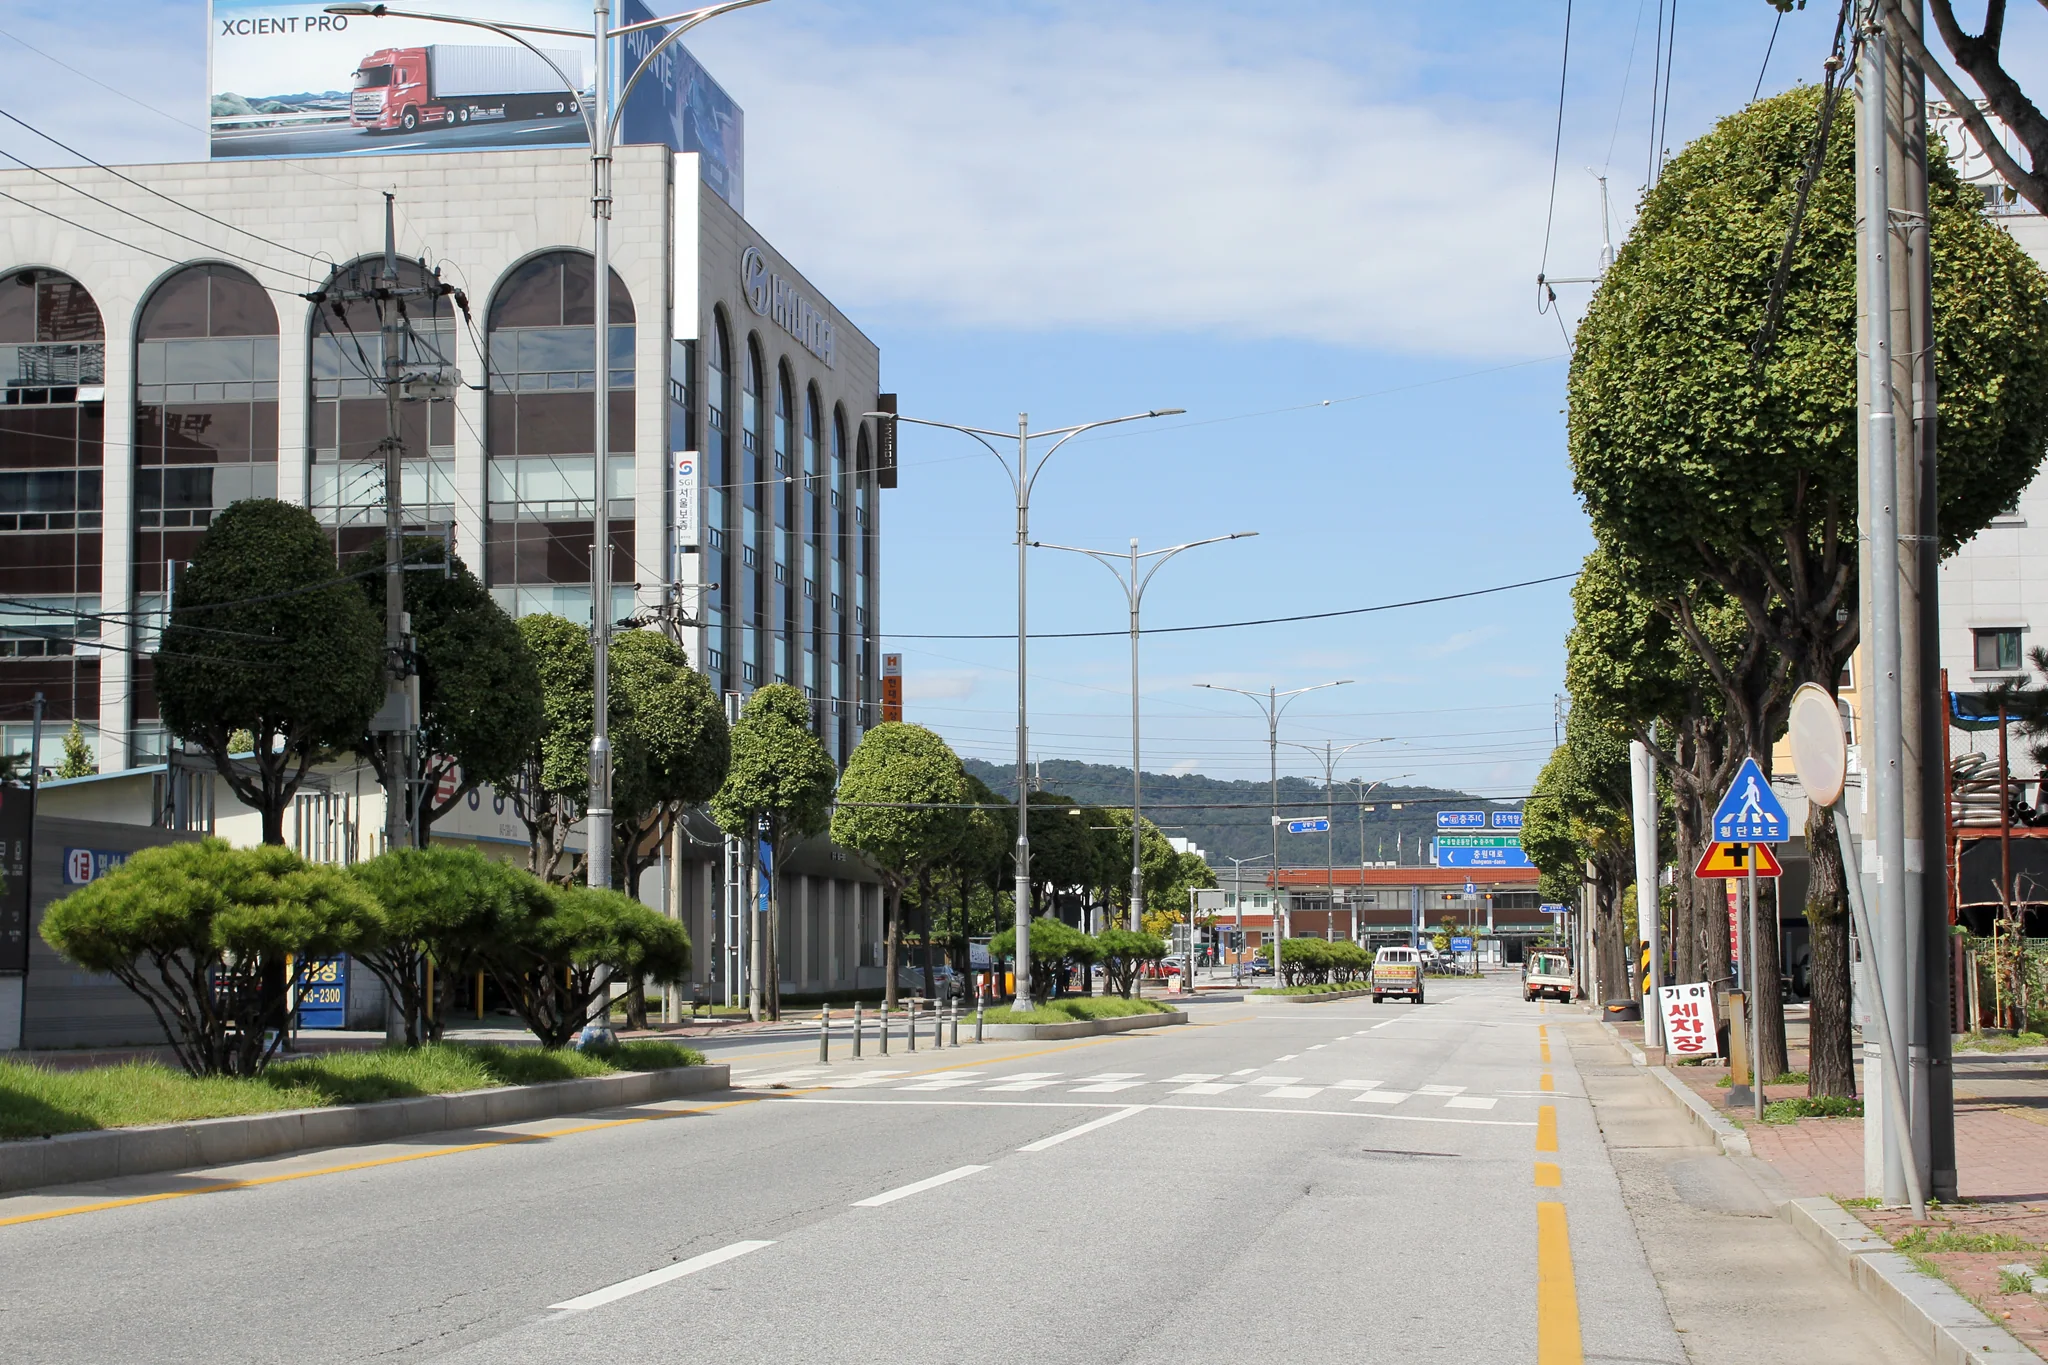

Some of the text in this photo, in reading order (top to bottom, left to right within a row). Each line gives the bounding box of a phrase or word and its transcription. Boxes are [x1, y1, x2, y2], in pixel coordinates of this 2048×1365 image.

[221, 14, 348, 36] XCIENT PRO
[627, 18, 673, 92] AVANTE
[678, 478, 693, 487] SGI
[679, 488, 689, 531] 서울보증
[1459, 814, 1483, 825] 충주IC
[1719, 826, 1780, 838] 횡단보도
[1473, 850, 1504, 859] 충원대로
[72, 852, 91, 881] 1급
[1664, 986, 1706, 1000] 기아
[1667, 1002, 1708, 1052] 세차장
